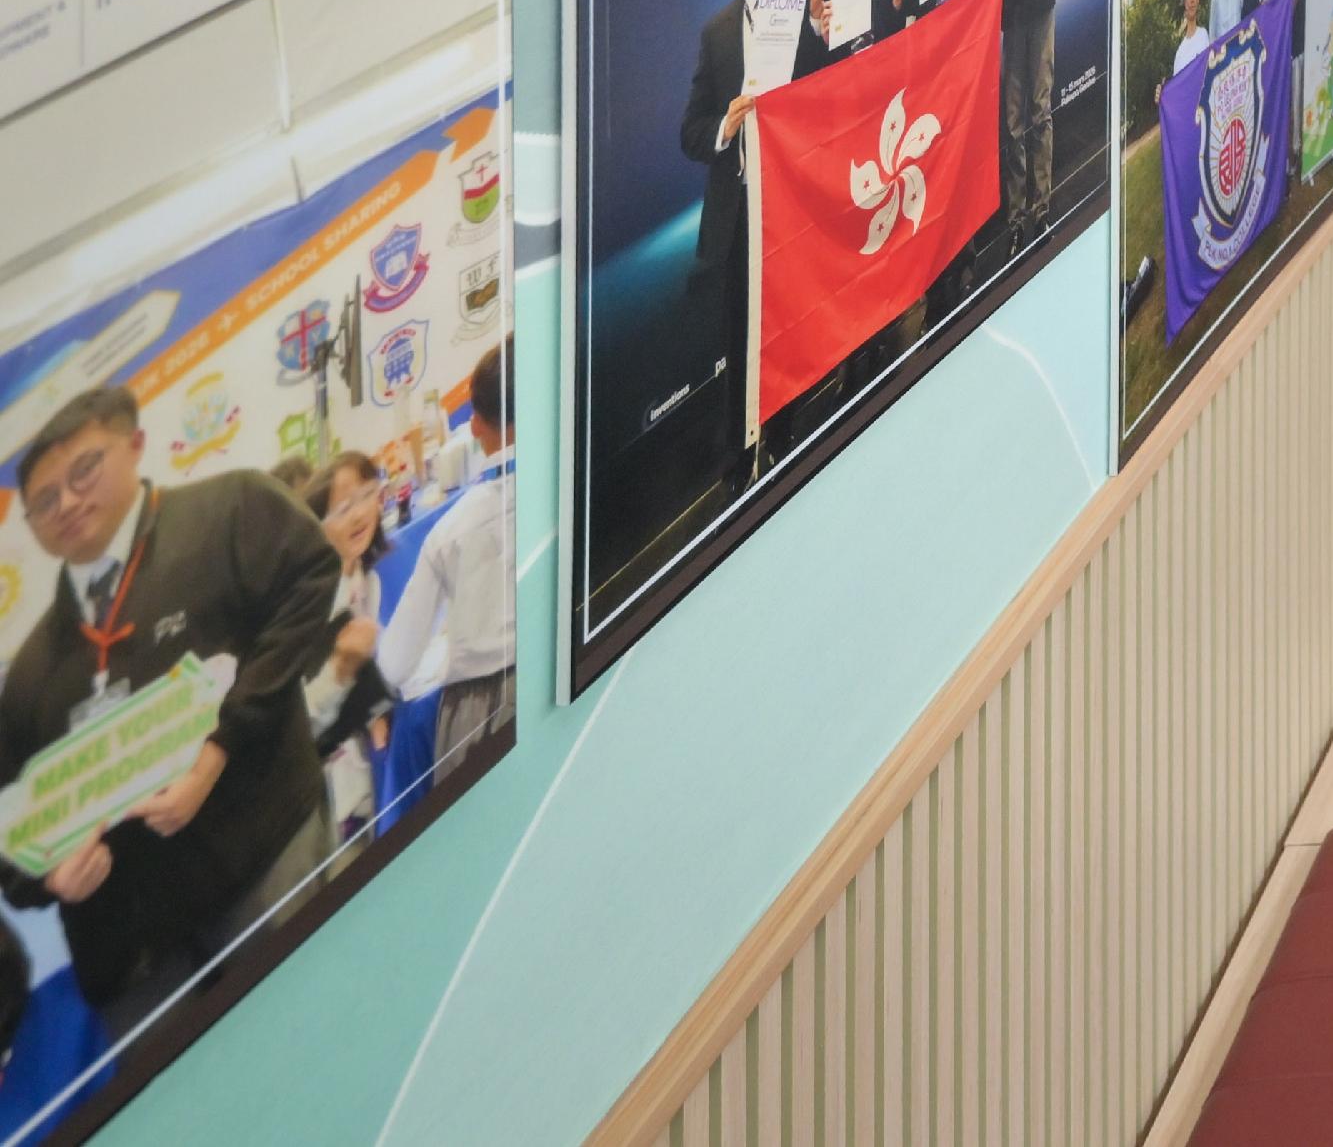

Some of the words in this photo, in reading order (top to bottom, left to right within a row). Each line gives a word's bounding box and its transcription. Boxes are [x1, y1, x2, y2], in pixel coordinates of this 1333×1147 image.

[244, 247, 320, 309] SCHOOL
[322, 180, 401, 251] SHARING
[32, 731, 111, 799] MAKE
[117, 680, 195, 748] YOUR
[8, 794, 71, 851] MINI
